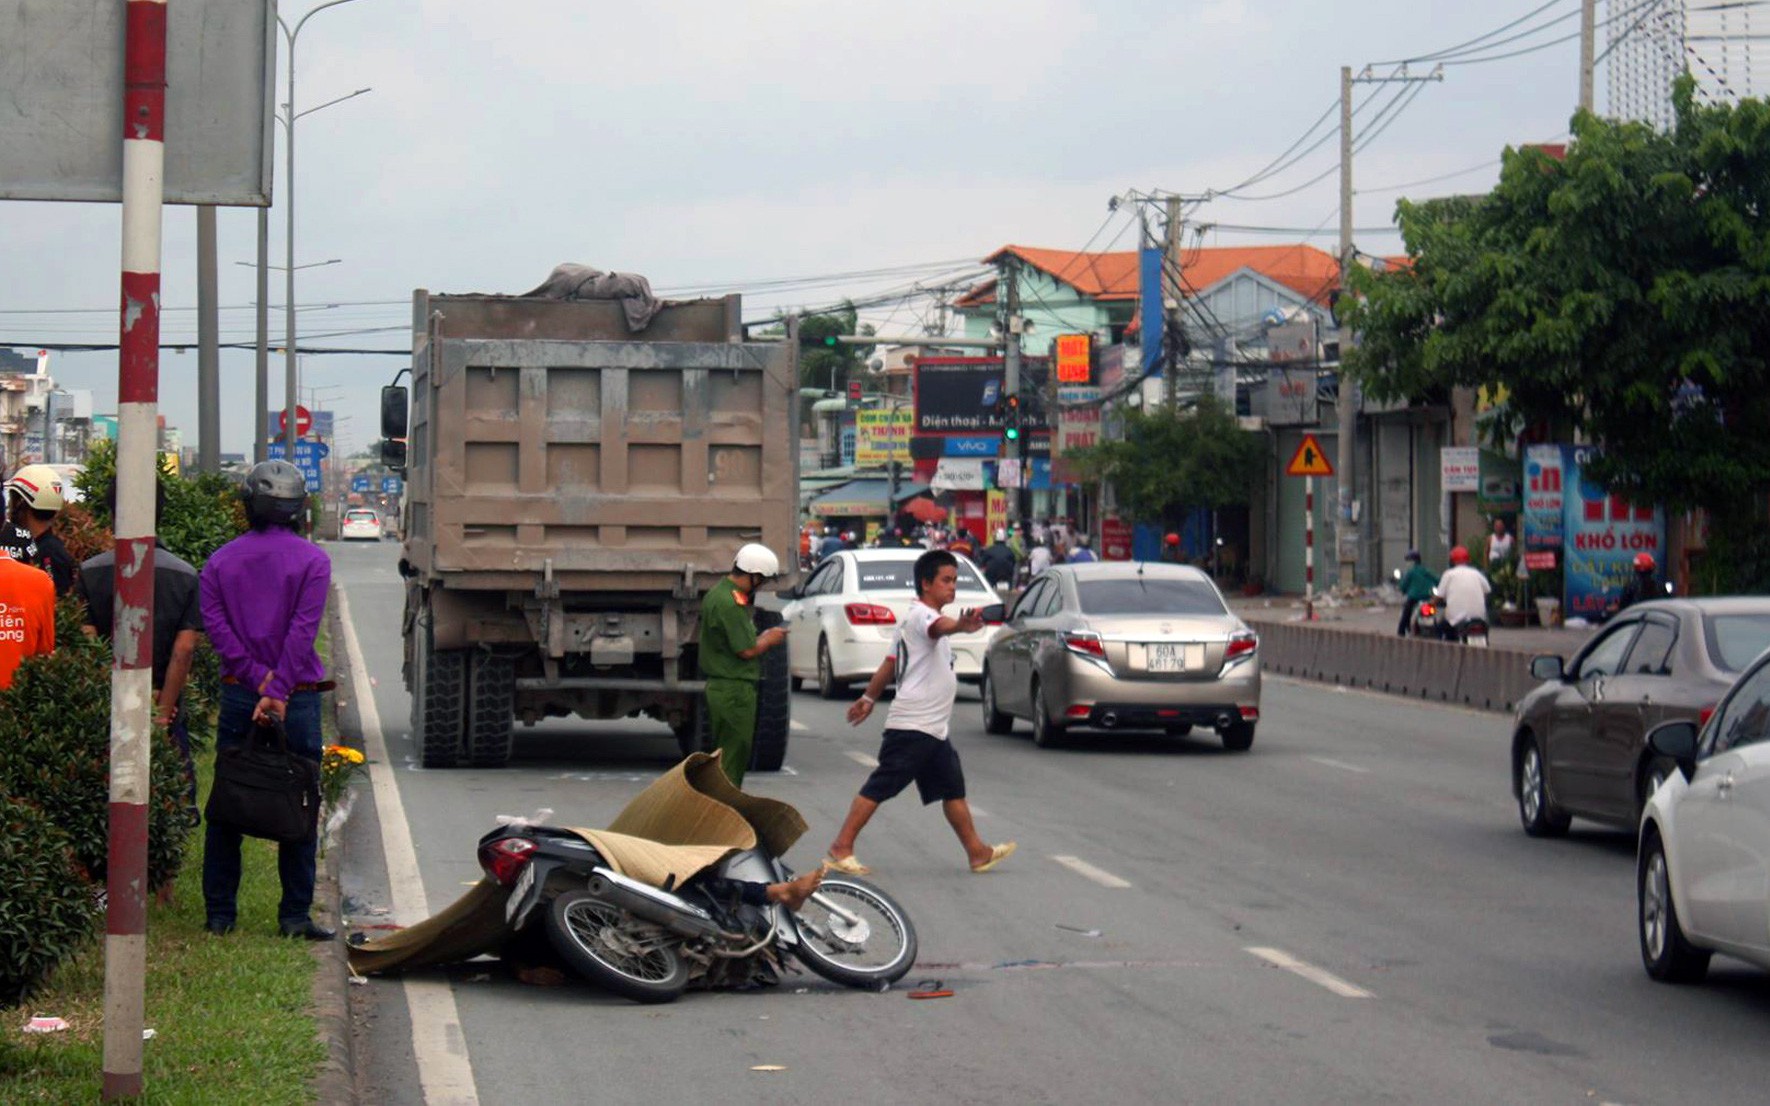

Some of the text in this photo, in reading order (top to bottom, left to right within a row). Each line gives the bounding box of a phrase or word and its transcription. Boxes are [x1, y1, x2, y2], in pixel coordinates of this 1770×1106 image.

[922, 415, 943, 428] Điện
[951, 415, 980, 429] thoại
[1575, 526, 1616, 550] KHỔ
